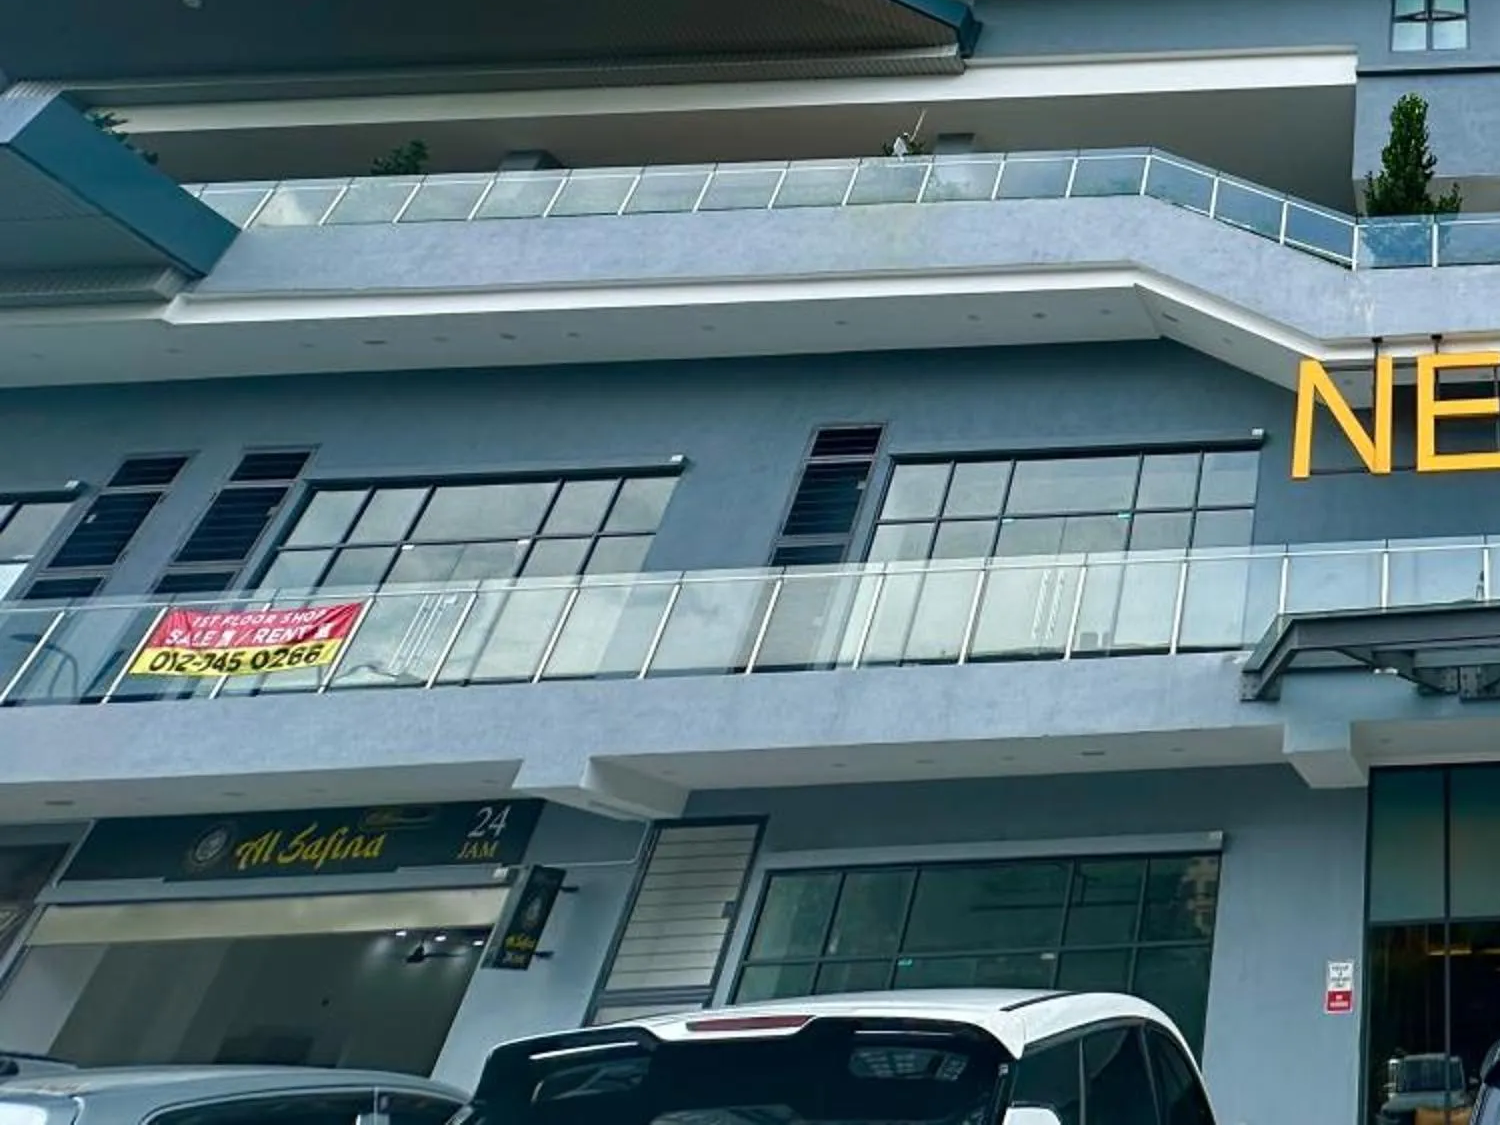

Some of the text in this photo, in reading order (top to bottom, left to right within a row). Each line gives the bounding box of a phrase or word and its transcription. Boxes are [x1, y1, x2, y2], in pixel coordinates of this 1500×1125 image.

[221, 613, 277, 626] FLOOR
[280, 609, 327, 624] SHOP
[165, 629, 217, 646] SALE
[252, 625, 314, 644] RENT
[468, 805, 512, 837] 24
[235, 822, 387, 871] Al Safina
[457, 841, 500, 860] JAM
